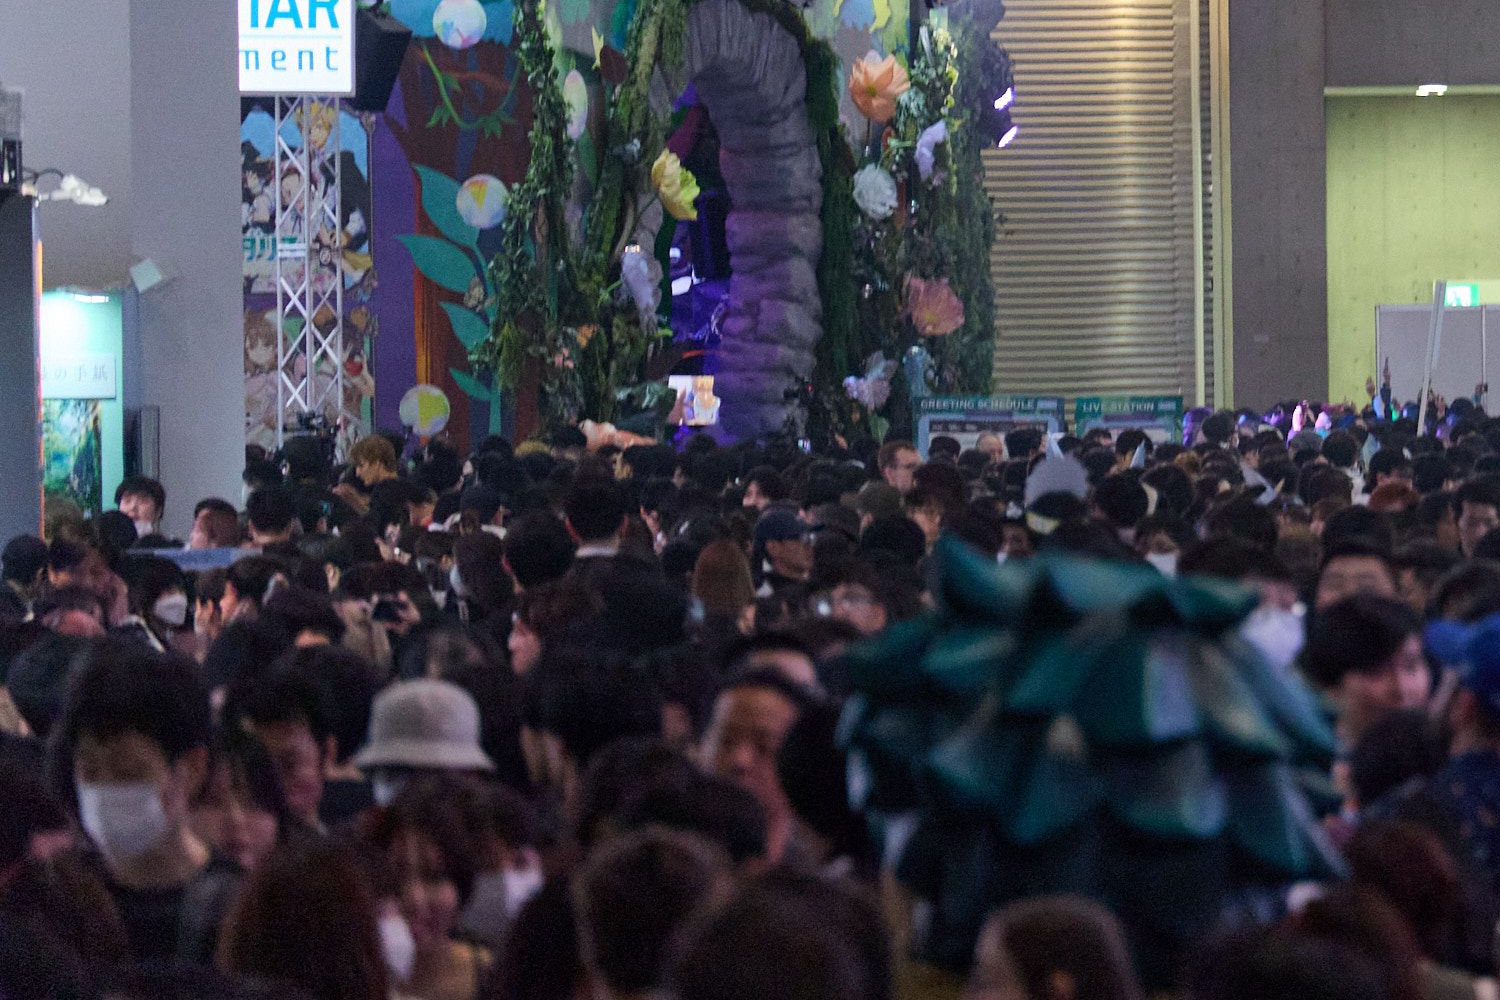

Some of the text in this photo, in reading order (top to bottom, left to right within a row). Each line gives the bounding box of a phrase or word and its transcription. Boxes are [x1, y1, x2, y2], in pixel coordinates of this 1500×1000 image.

[920, 399, 975, 410] GREETING
[977, 399, 1035, 410] SCHEDULE
[1082, 401, 1106, 412] LIVE
[1110, 401, 1155, 412] STATION
